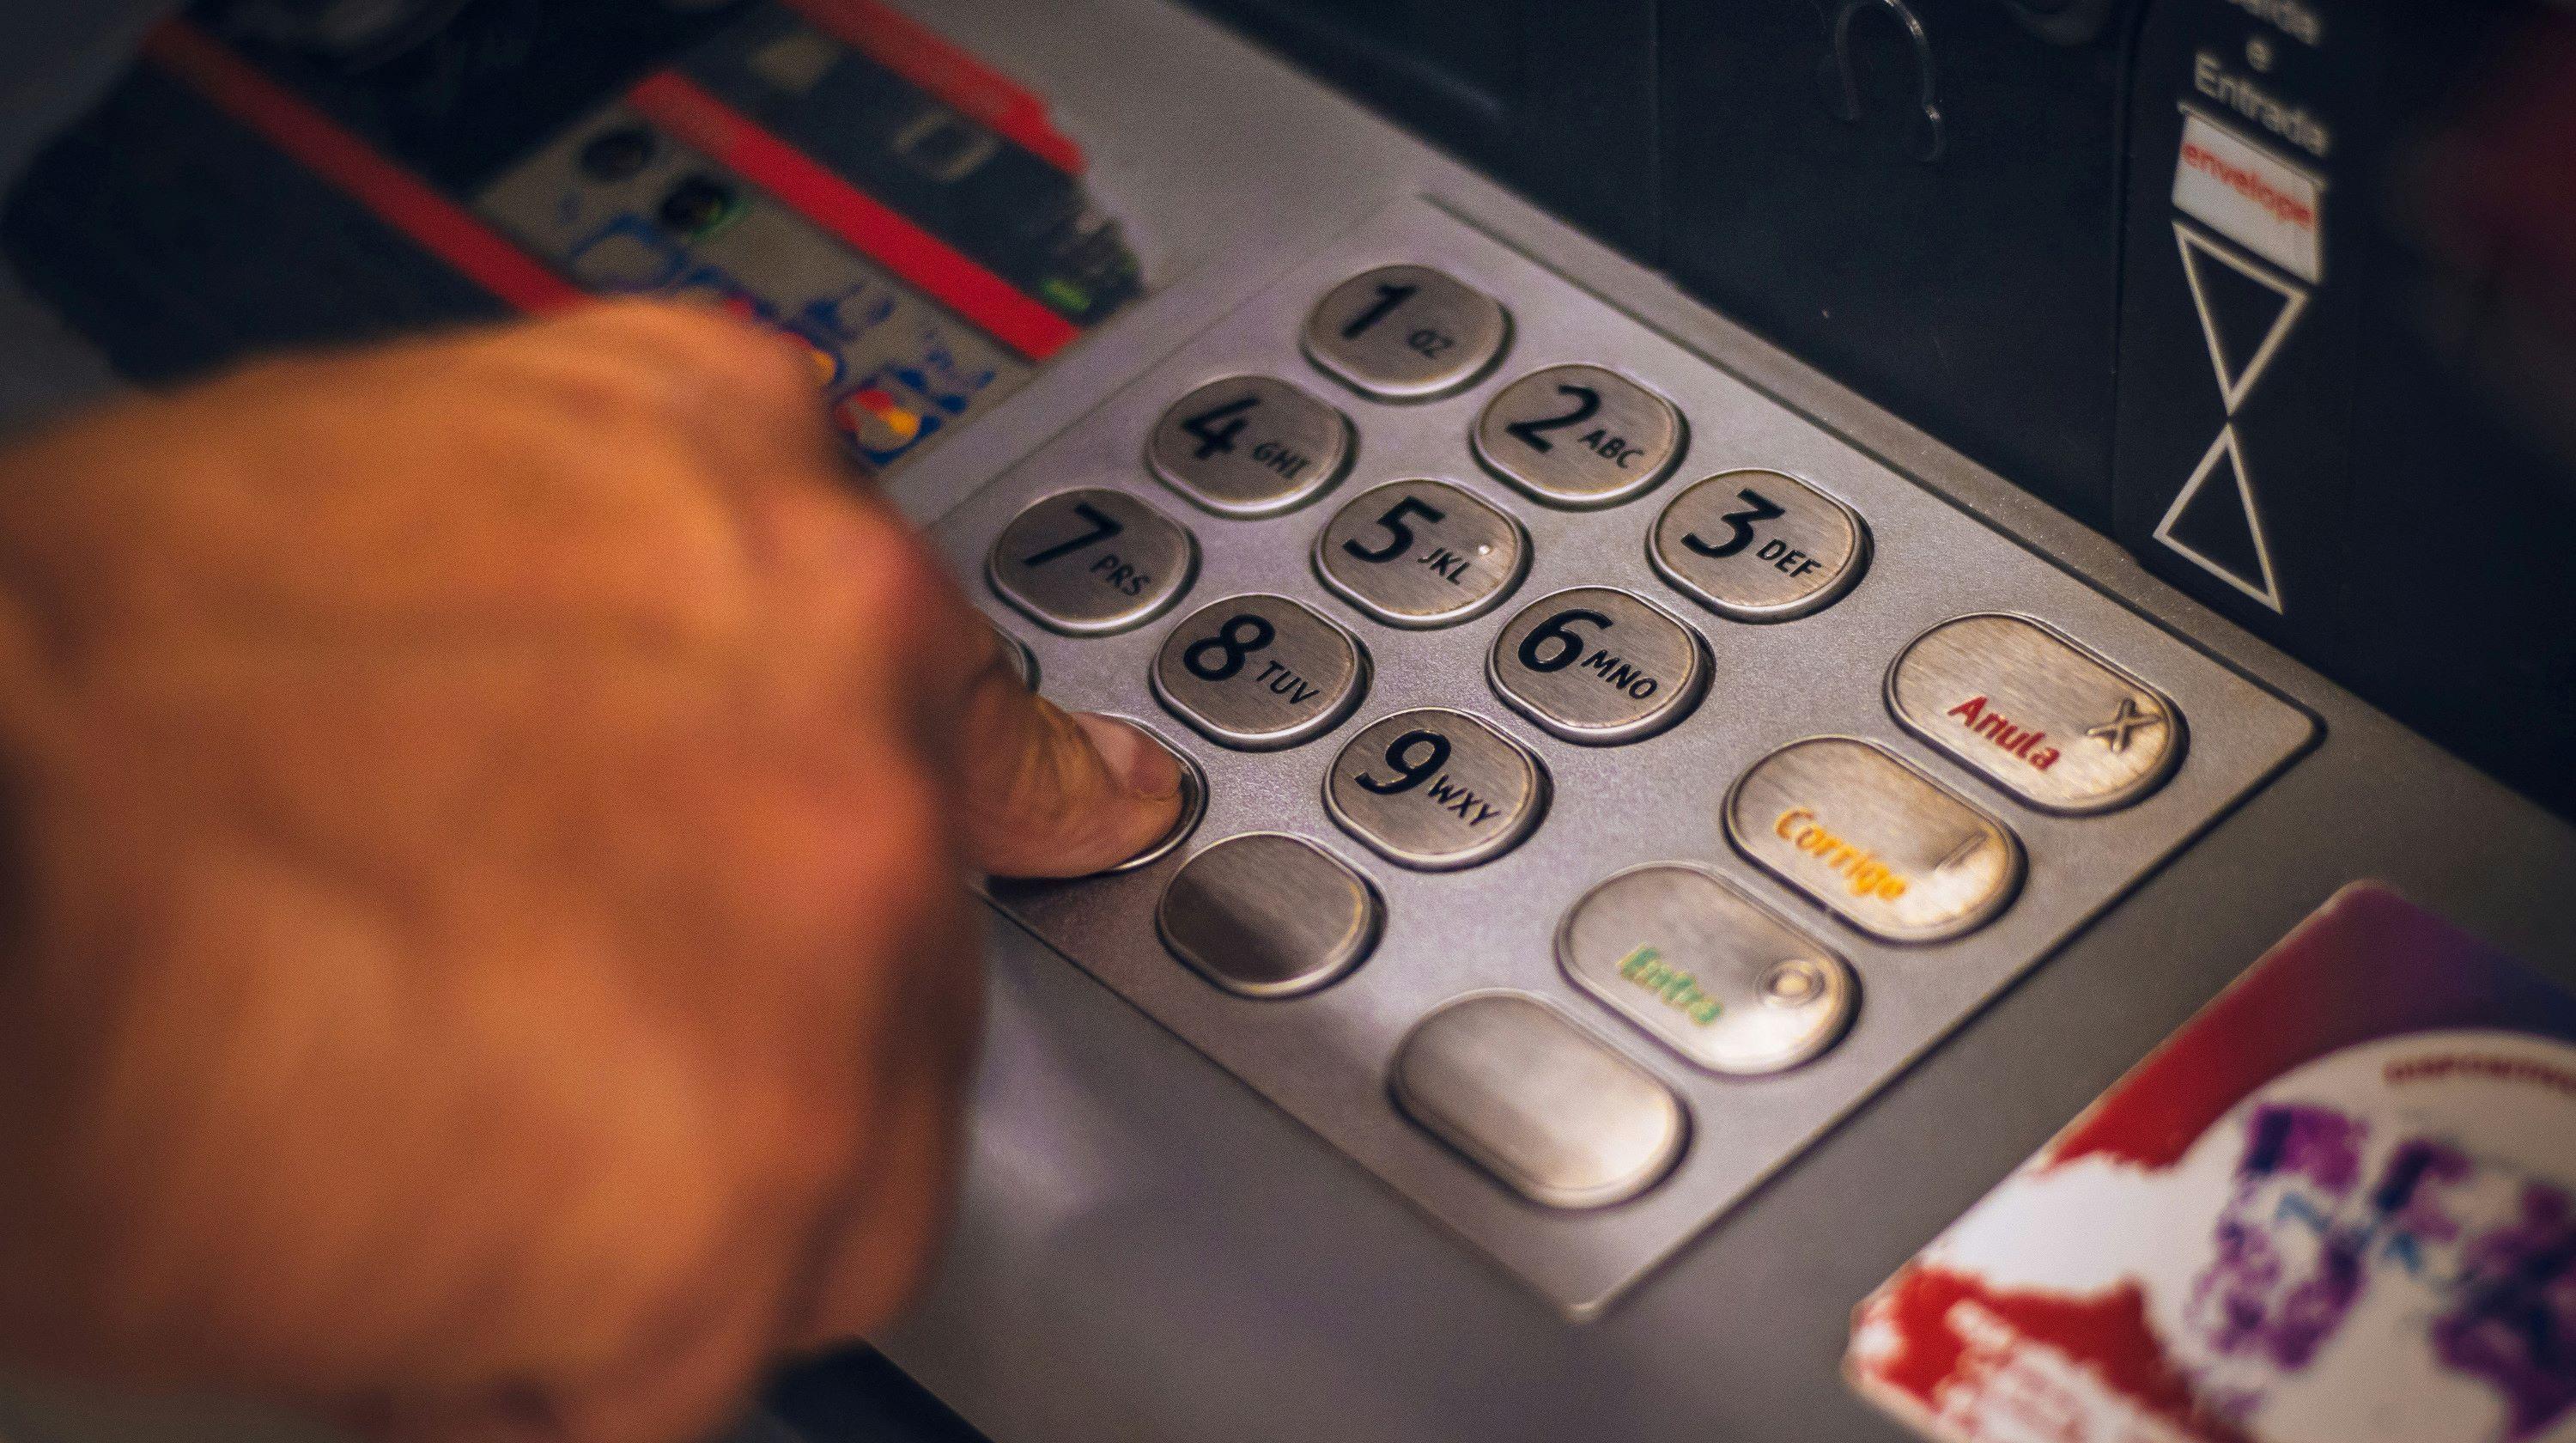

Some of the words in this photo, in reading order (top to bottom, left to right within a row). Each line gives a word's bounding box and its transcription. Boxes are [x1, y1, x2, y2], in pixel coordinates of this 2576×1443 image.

[2245, 40, 2273, 72] e
[2195, 51, 2329, 158] Entrada
[2181, 143, 2315, 232] envelope
[1340, 284, 1418, 339] 1
[1180, 394, 1261, 460] 4
[1254, 441, 1310, 479] GHI
[1506, 385, 1601, 454] 2
[1579, 429, 1644, 469] ABC
[1024, 502, 1123, 568] 7
[1091, 553, 1151, 596] PRS
[1342, 496, 1446, 563] 5
[1417, 547, 1470, 586] JKL
[1680, 488, 1785, 558] 3
[1756, 539, 1822, 578] DEF
[1183, 613, 1276, 681] 8
[1256, 660, 1320, 704] TUV
[1518, 608, 1613, 673] 6
[1581, 648, 1658, 700] MNO
[1353, 729, 1452, 795] 9
[1428, 773, 1501, 827] WXY
[1947, 695, 2061, 771] Anula
[1774, 804, 1909, 902] Corrige
[1617, 944, 1724, 1025] Entra
